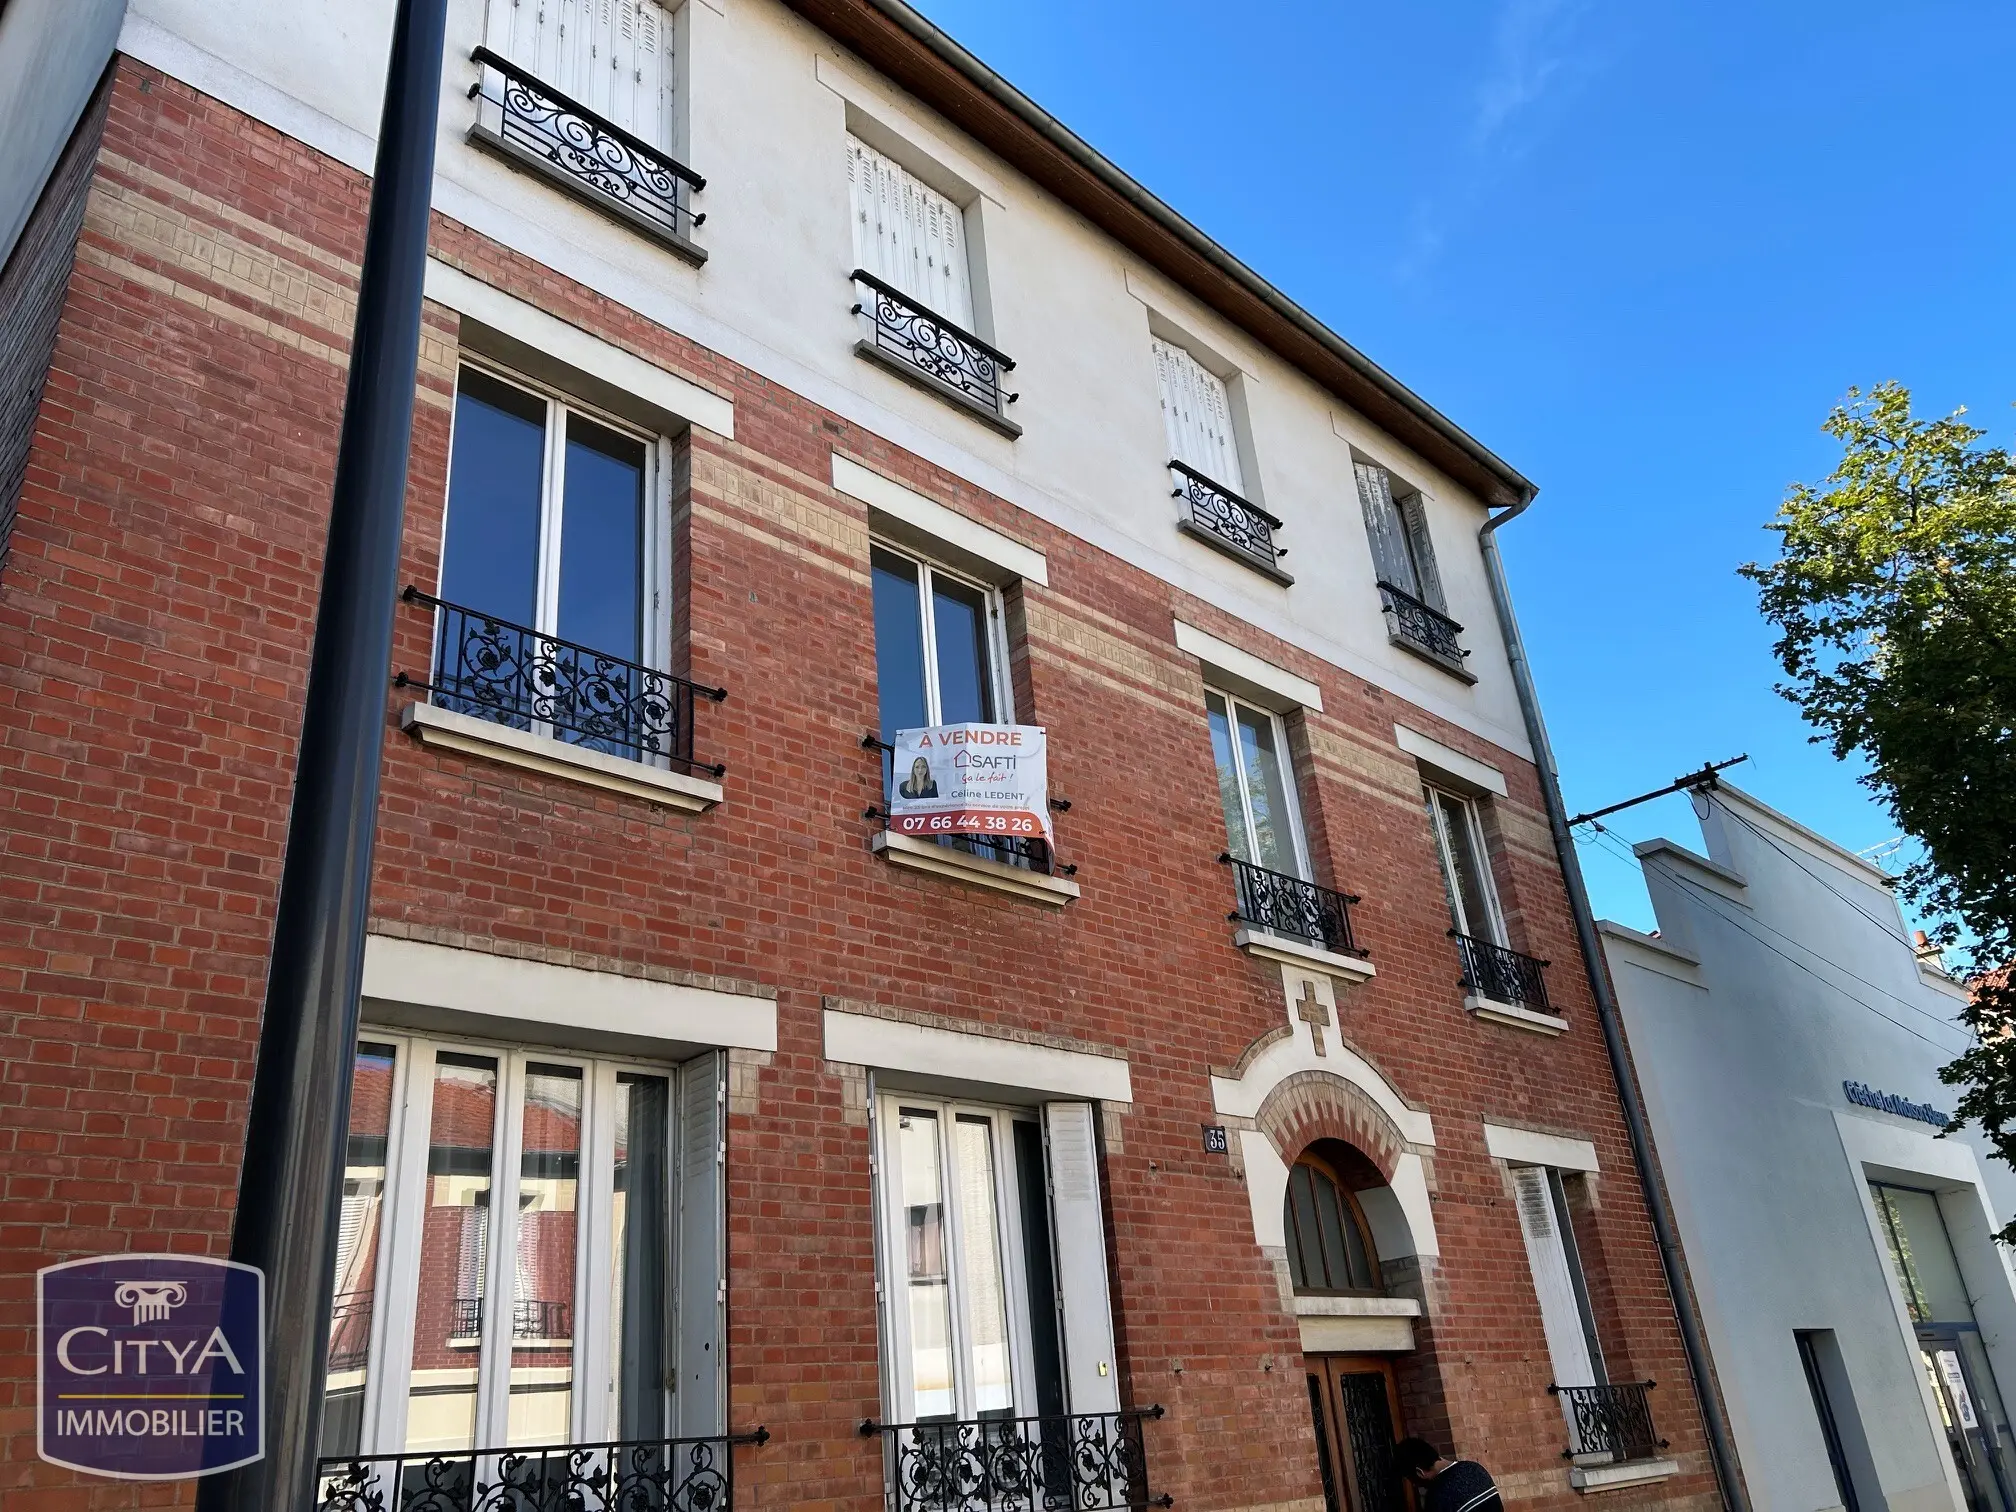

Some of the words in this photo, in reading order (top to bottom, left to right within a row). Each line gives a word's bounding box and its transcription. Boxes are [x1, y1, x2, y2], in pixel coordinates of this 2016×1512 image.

[918, 731, 933, 748] À
[938, 729, 1022, 746] VENDRE
[975, 772, 986, 781] le
[987, 771, 1007, 783] fait
[951, 789, 982, 799] Céline
[984, 791, 1025, 801] LEDENT
[903, 817, 925, 830] 07
[930, 816, 952, 829] 66
[957, 814, 981, 828] 44
[985, 816, 1007, 829] 38
[1011, 817, 1033, 832] 26
[1210, 1129, 1225, 1149] 35
